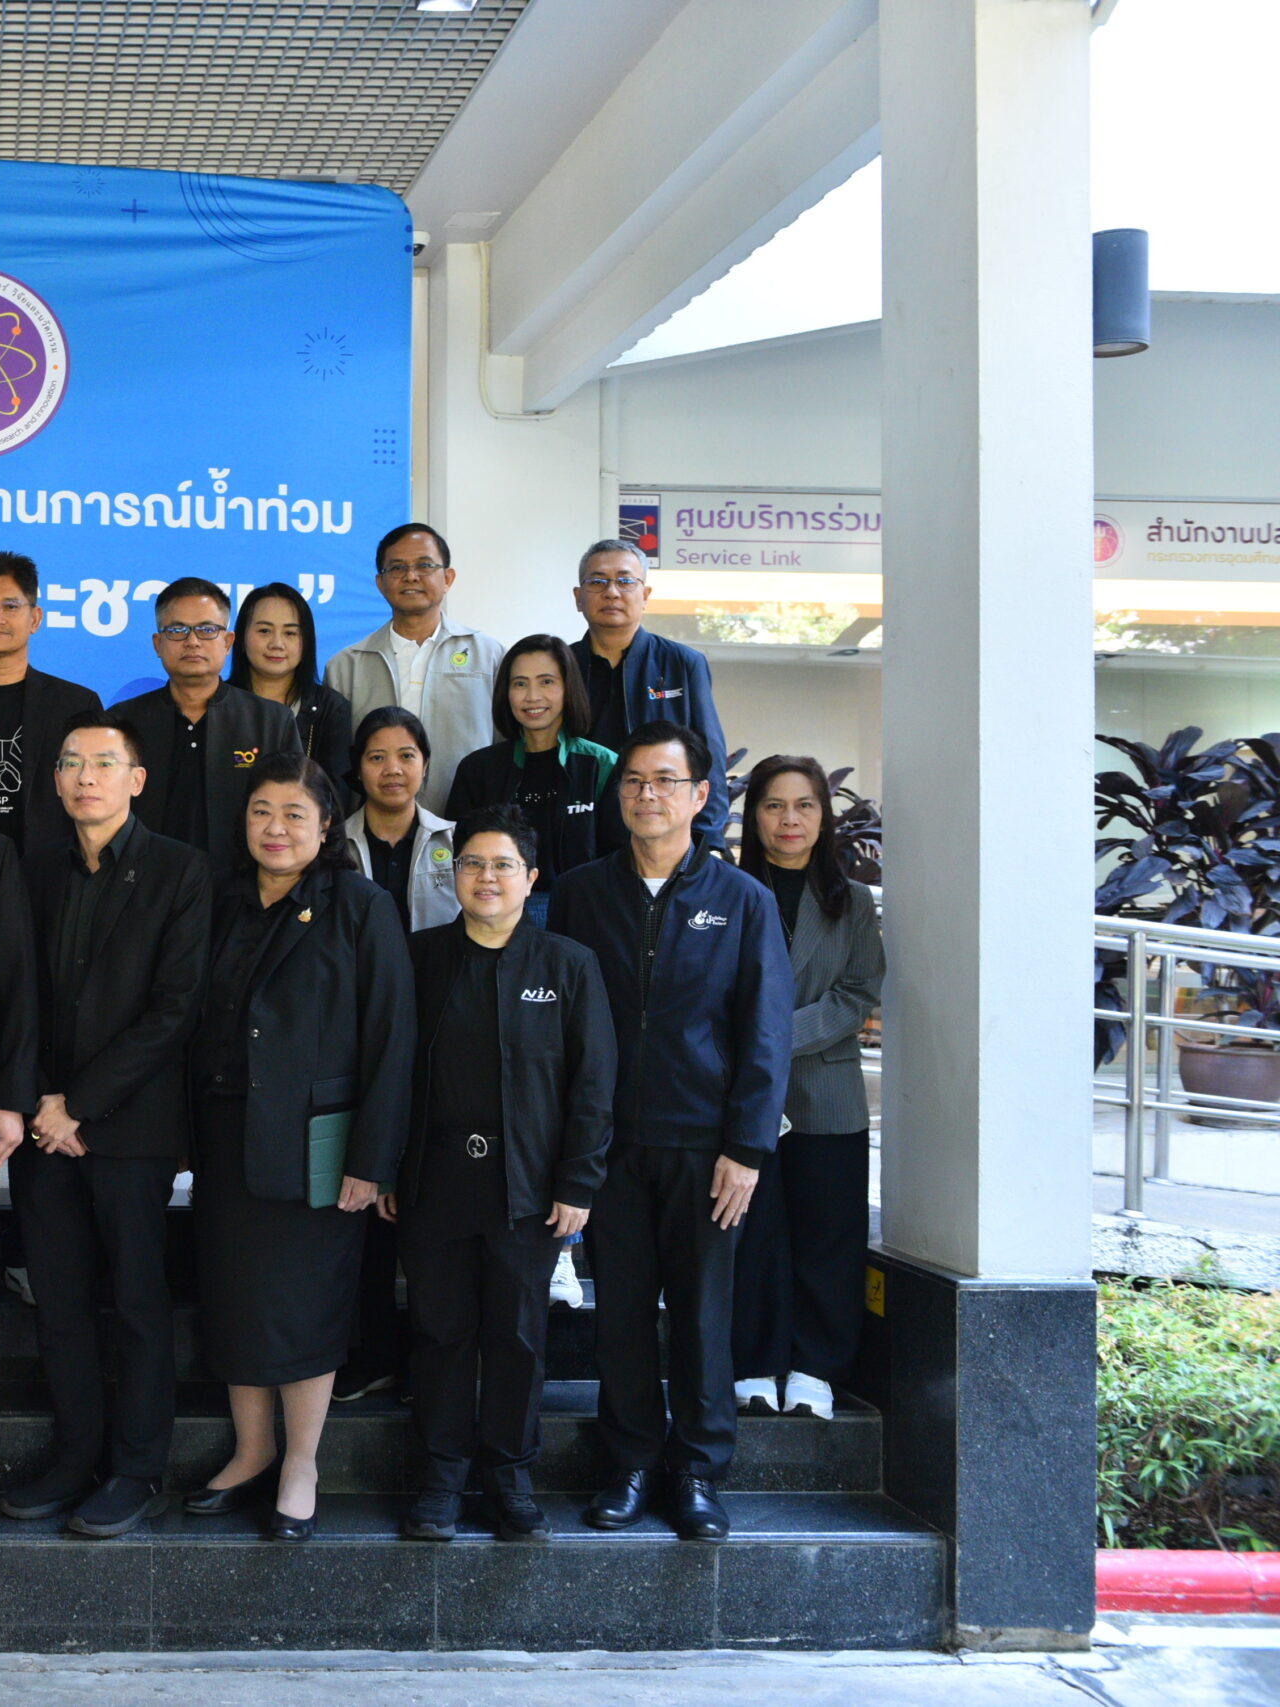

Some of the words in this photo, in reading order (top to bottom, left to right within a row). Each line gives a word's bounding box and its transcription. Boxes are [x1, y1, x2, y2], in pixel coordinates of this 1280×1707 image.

[24, 416, 37, 430] and
[35, 380, 57, 417] Innovation
[675, 501, 881, 537] ศูนย์บริการร่วม
[676, 548, 752, 566] Service
[761, 549, 801, 567] Link
